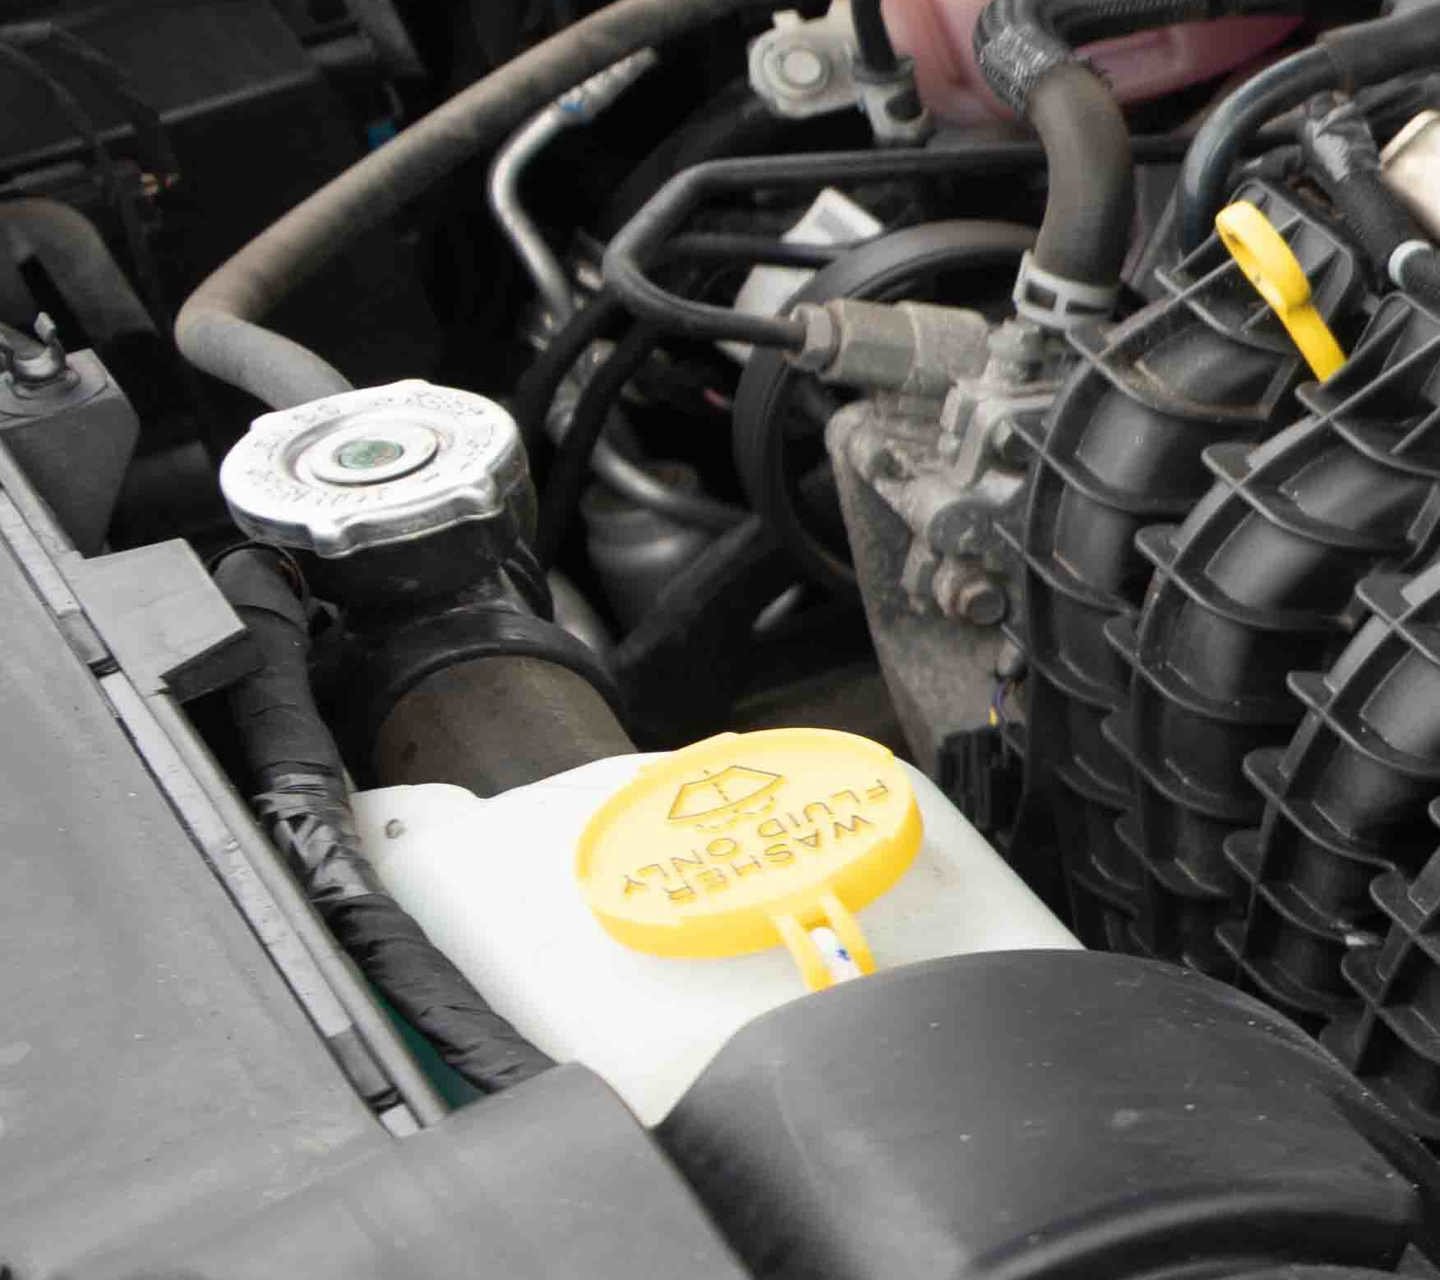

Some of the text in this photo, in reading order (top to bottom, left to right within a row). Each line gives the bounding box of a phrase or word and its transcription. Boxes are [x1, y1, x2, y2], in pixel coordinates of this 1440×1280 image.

[622, 778, 889, 896] FLUID ONLY
[665, 813, 873, 902] WASHER
